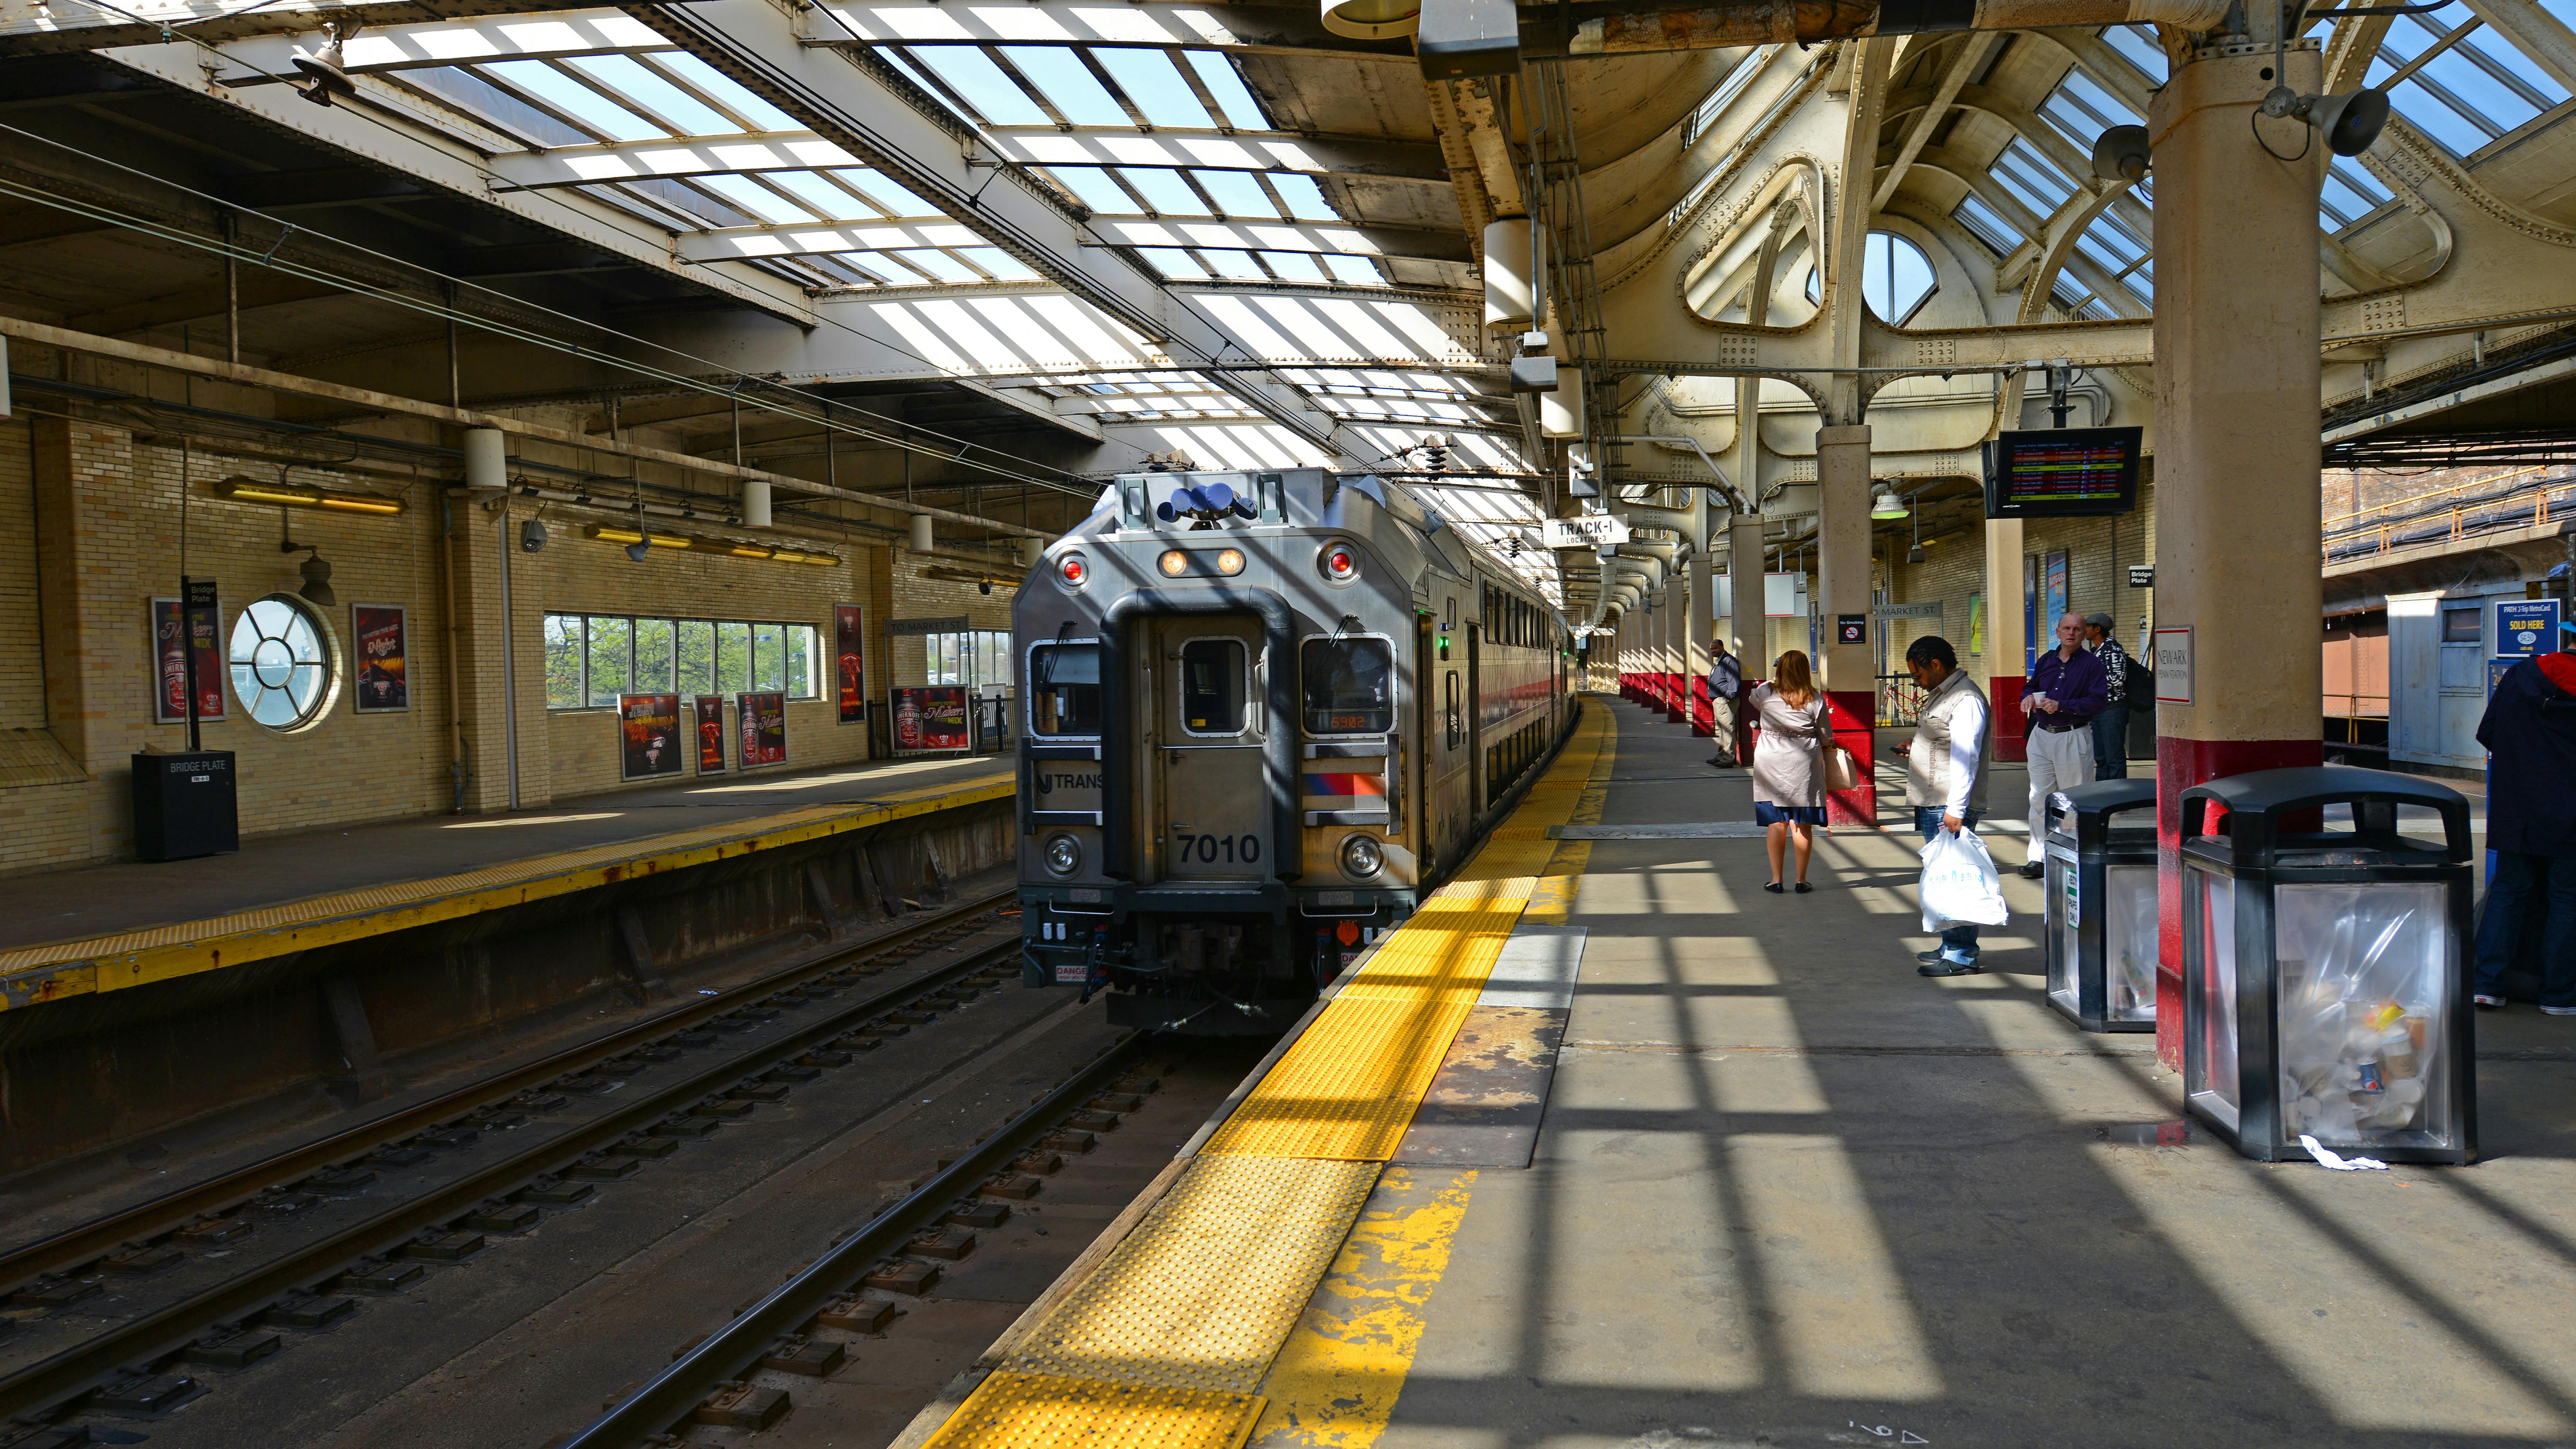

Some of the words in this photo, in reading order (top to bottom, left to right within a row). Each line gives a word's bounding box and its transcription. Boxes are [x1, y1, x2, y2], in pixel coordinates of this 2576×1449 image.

[1567, 535, 1606, 544] LOCATION-3
[2531, 585, 2537, 594] 8
[1882, 607, 1920, 615] MARKET
[891, 624, 905, 632] TO
[908, 622, 945, 631] MARKET
[951, 621, 961, 629] ST.
[2509, 621, 2527, 630] SOLD
[2527, 620, 2545, 630] HERE
[2158, 650, 2187, 664] NEWARK
[165, 664, 184, 675] SMIRN
[2170, 670, 2187, 679] STATION
[897, 712, 920, 720] SMIRNOFF
[923, 705, 965, 719] Makers
[1332, 716, 1364, 728] 5902
[170, 761, 200, 773] BRIDGE
[203, 760, 226, 771] PLATE
[1054, 774, 1102, 789] TRANS
[1177, 834, 1260, 864] 7010
